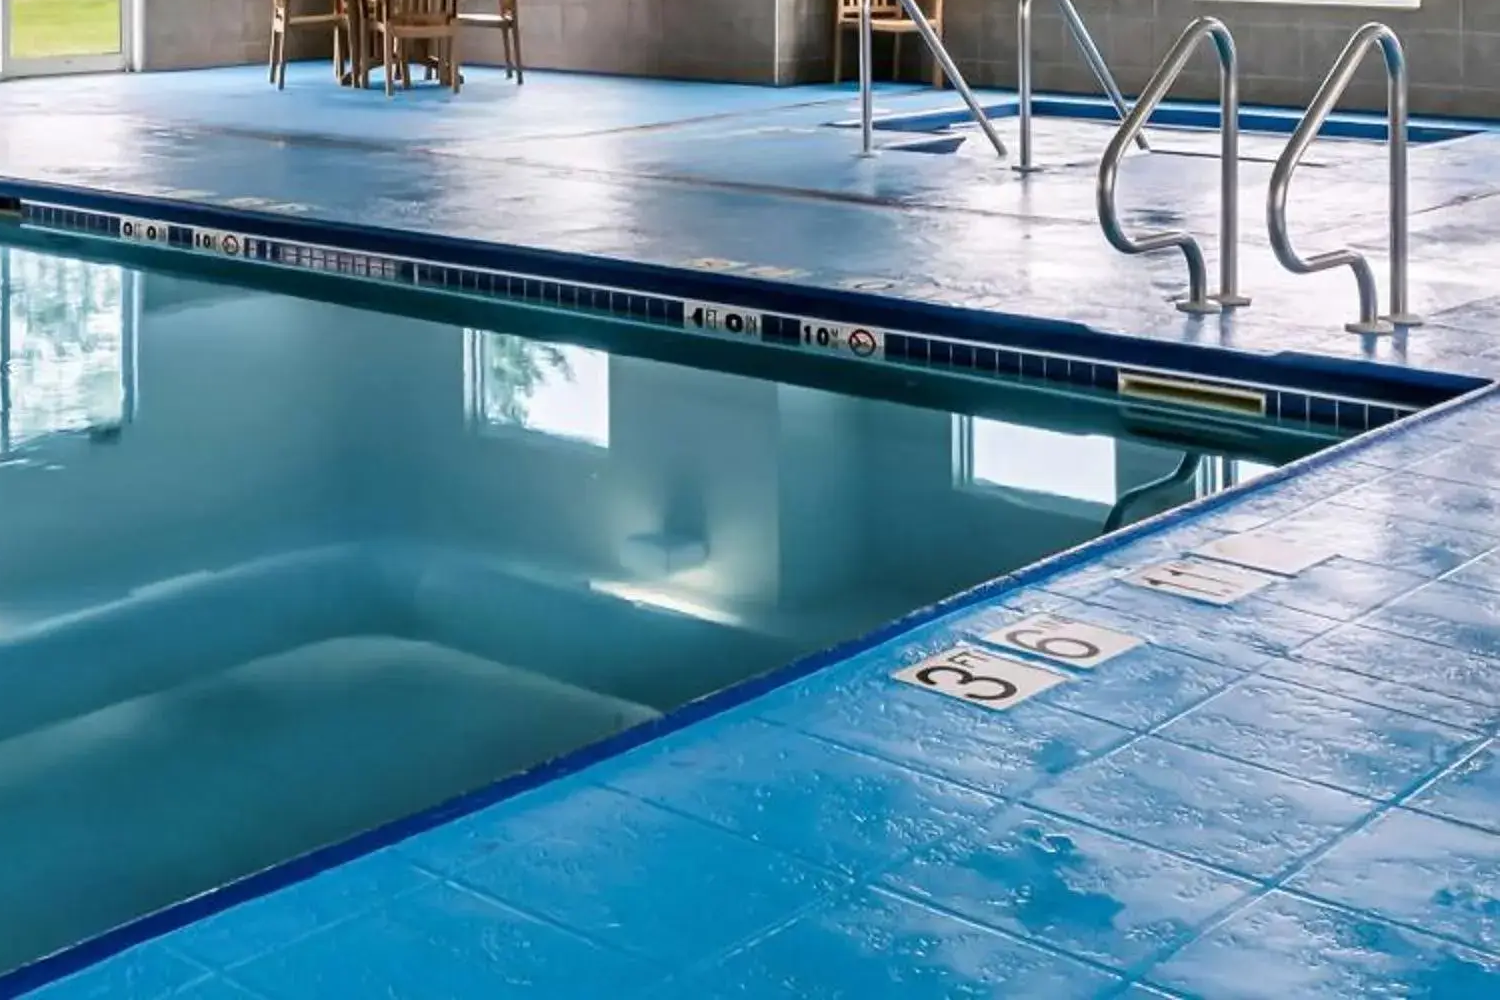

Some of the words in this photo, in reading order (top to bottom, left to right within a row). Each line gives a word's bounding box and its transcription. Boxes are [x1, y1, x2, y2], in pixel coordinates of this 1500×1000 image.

[1005, 628, 1101, 659] 6
[947, 650, 989, 669] FT
[915, 664, 1018, 701] 3
